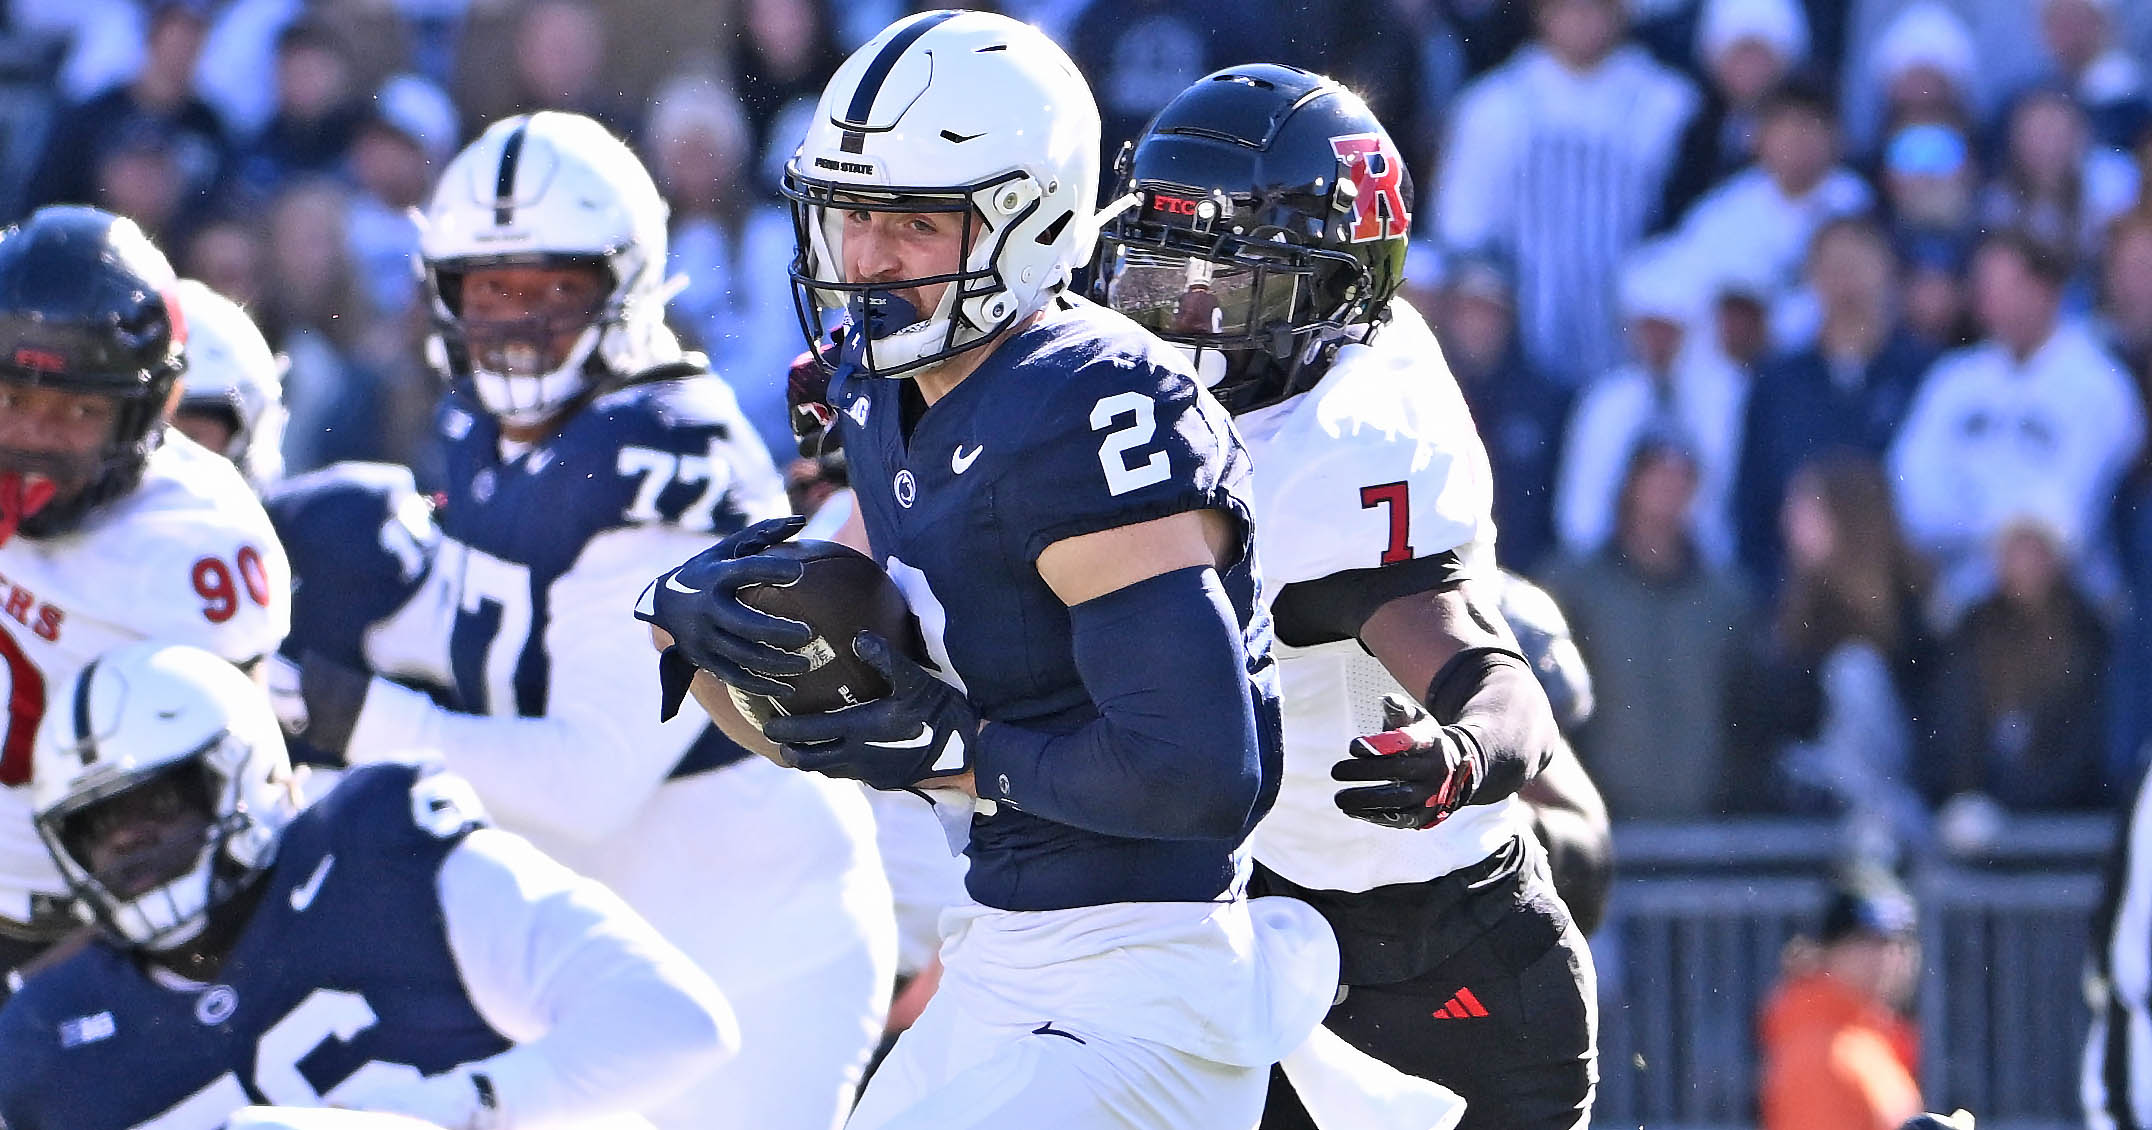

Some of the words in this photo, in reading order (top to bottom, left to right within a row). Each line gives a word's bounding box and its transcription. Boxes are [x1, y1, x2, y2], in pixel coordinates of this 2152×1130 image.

[841, 162, 874, 175] STATE
[1153, 194, 1198, 216] FTC
[1328, 132, 1412, 244] R
[1089, 391, 1172, 497] 2
[617, 446, 731, 530] 77
[1359, 480, 1414, 566] 7
[191, 546, 269, 623] 90
[434, 541, 533, 717] 7
